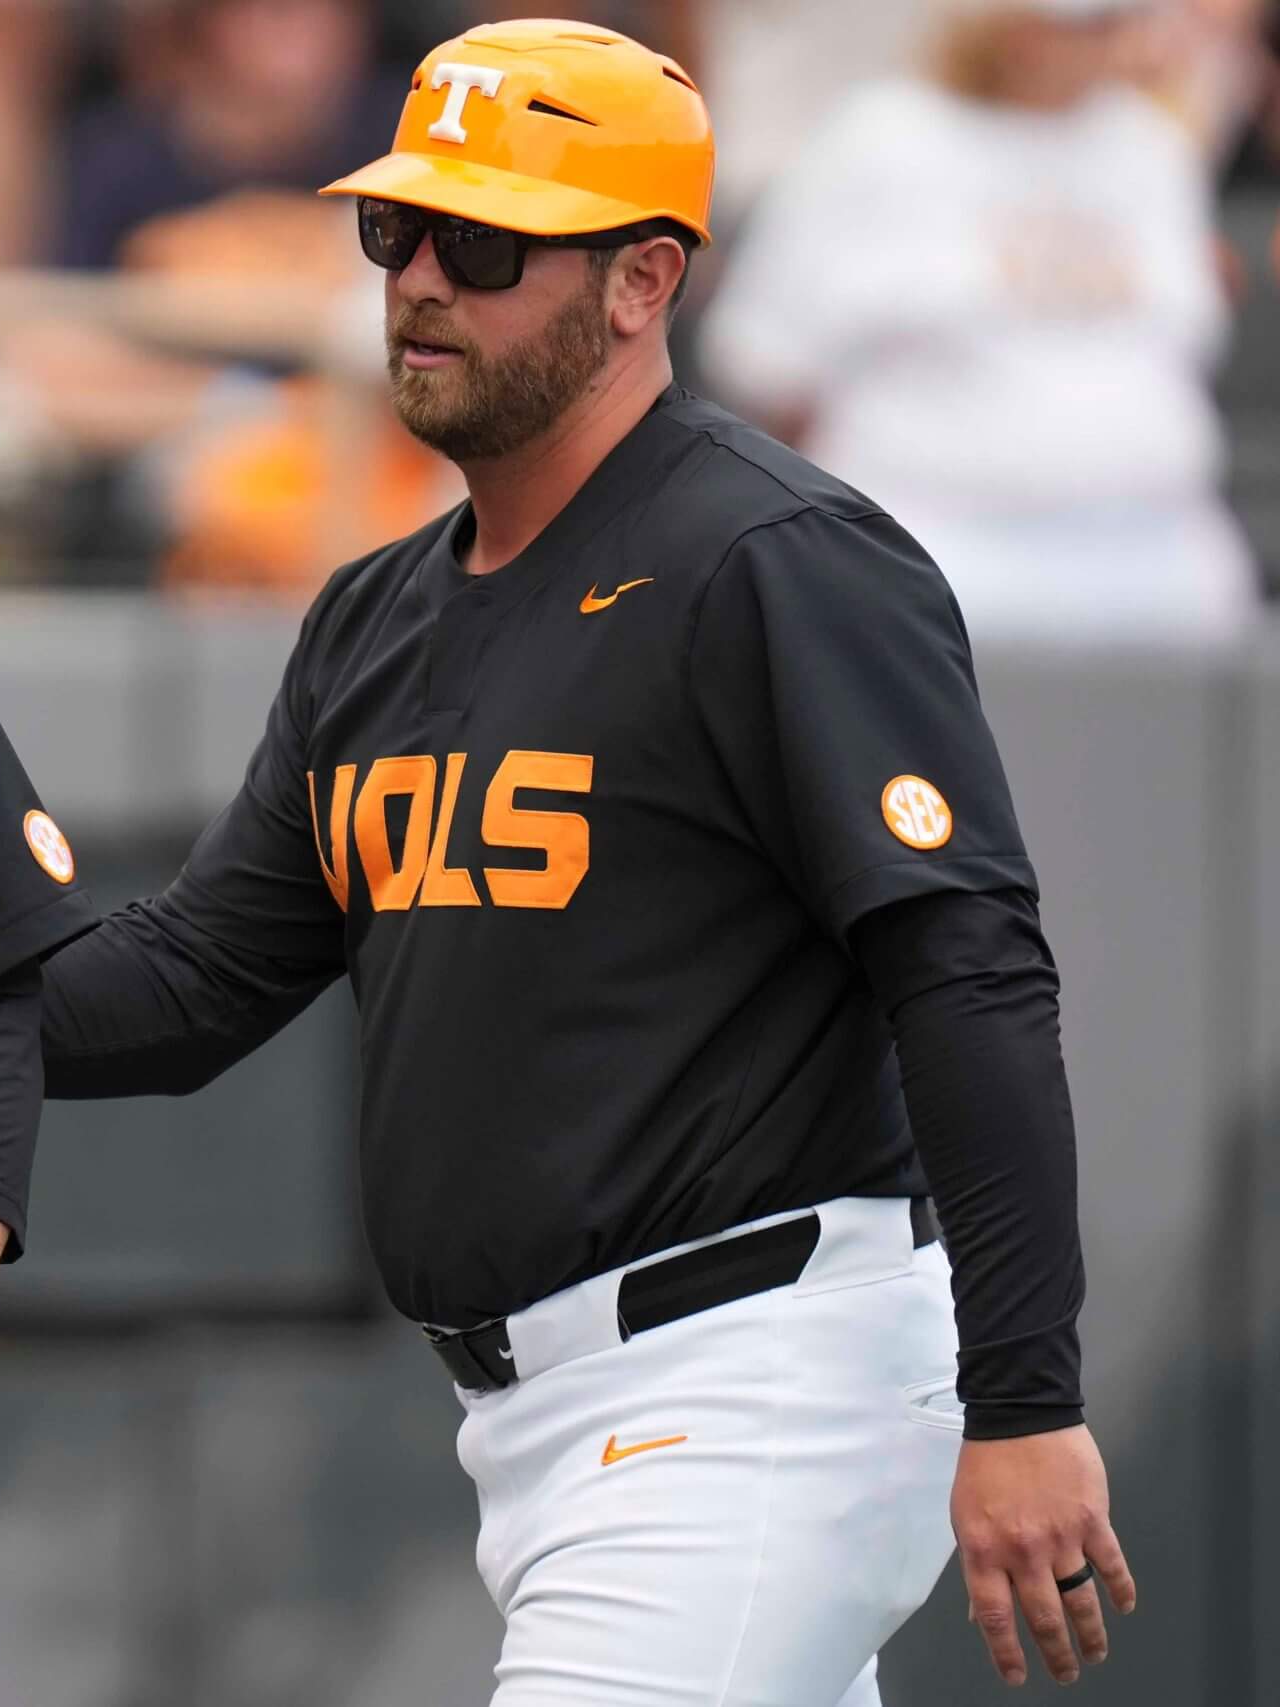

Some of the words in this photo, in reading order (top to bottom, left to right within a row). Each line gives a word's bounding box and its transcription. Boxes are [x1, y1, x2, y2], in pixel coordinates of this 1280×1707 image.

[427, 63, 504, 144] T
[307, 750, 594, 912] VOLS
[887, 780, 948, 843] SEC
